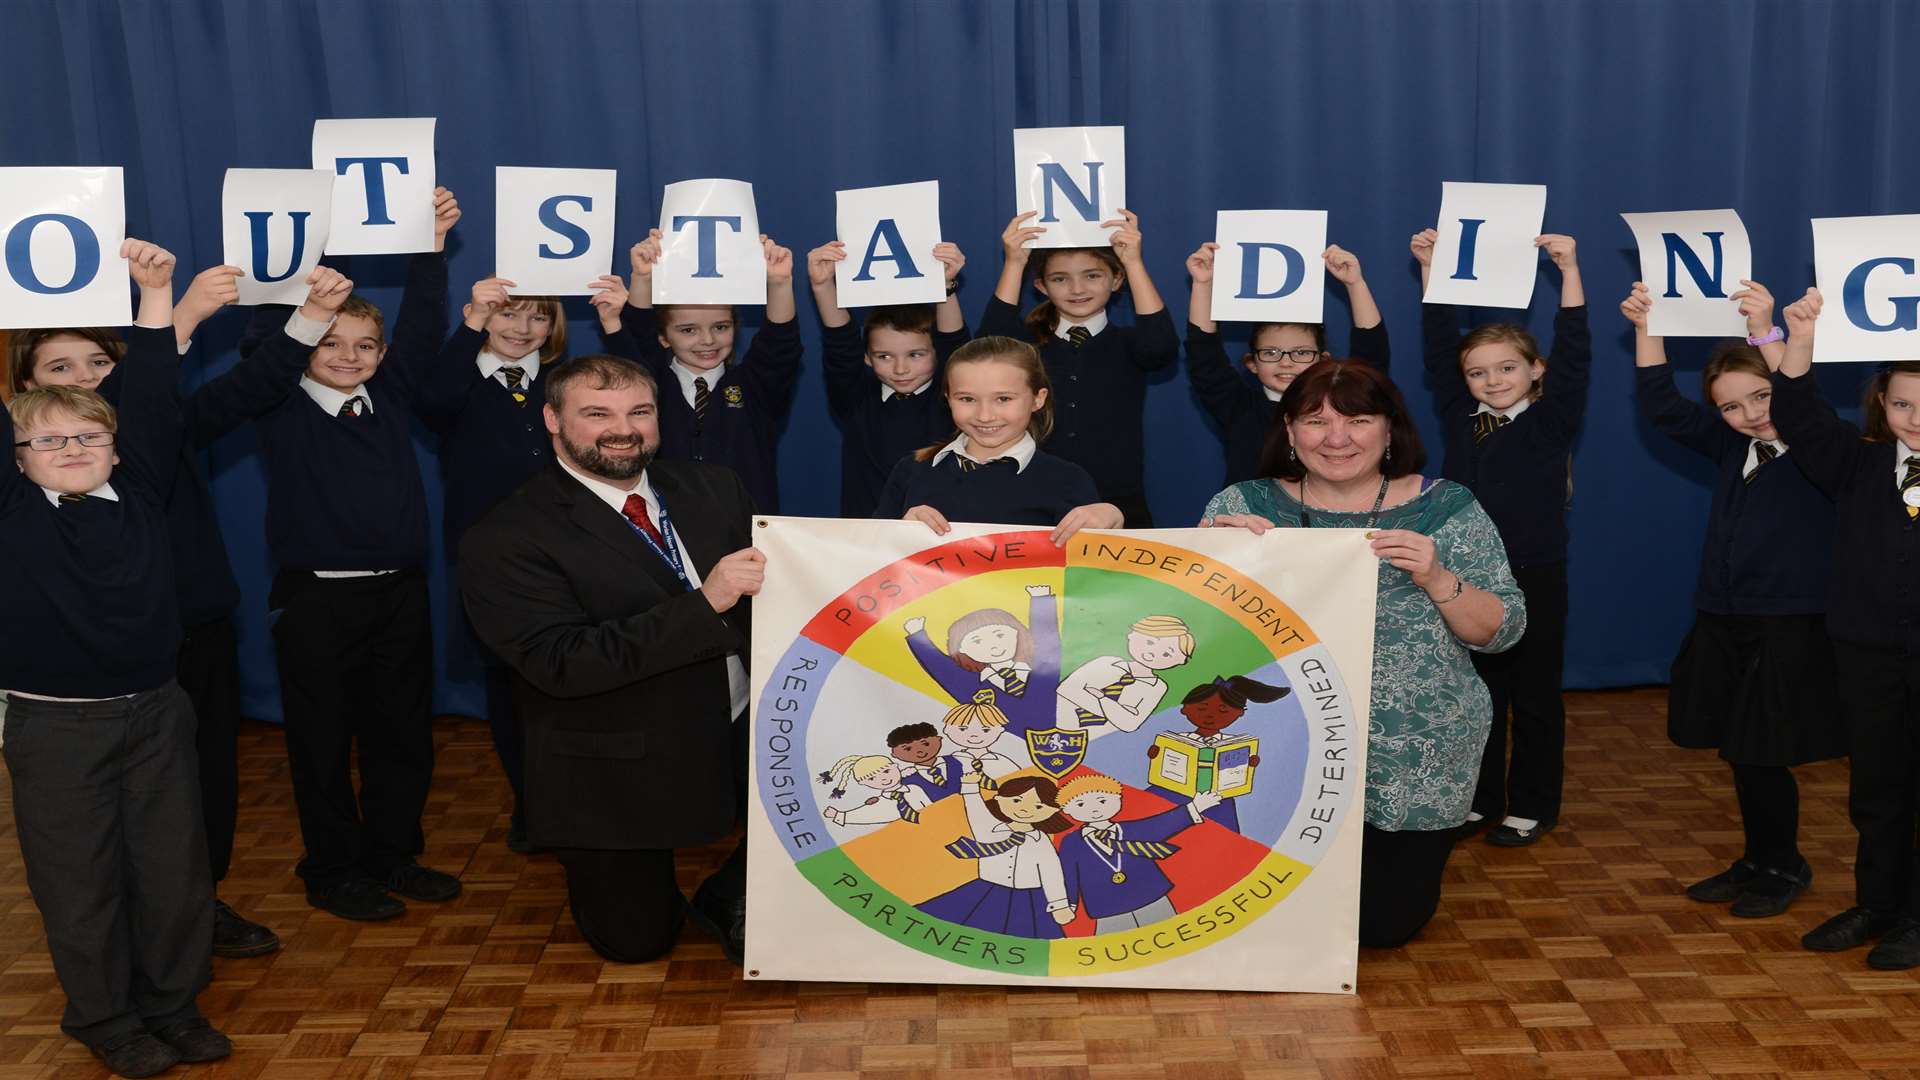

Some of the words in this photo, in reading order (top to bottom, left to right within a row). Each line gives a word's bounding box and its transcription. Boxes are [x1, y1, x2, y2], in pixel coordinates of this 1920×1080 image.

[335, 157, 409, 226] T
[538, 195, 593, 260] S
[1037, 161, 1104, 223] N
[5, 213, 101, 295] O
[243, 211, 311, 283] U
[672, 215, 741, 278] T
[852, 218, 925, 282] A
[1233, 242, 1305, 300] D
[1449, 218, 1486, 281] I
[1661, 231, 1728, 299] N
[1842, 256, 1920, 333] G
[834, 541, 1025, 627] POSITIVE
[1082, 543, 1305, 647] INDEPENDENT
[768, 656, 818, 848] RESPONSIBLE
[1299, 657, 1348, 844] DETERMINED
[833, 872, 1027, 965] PARTNERS
[1077, 867, 1293, 966] SUCCESSFUL
